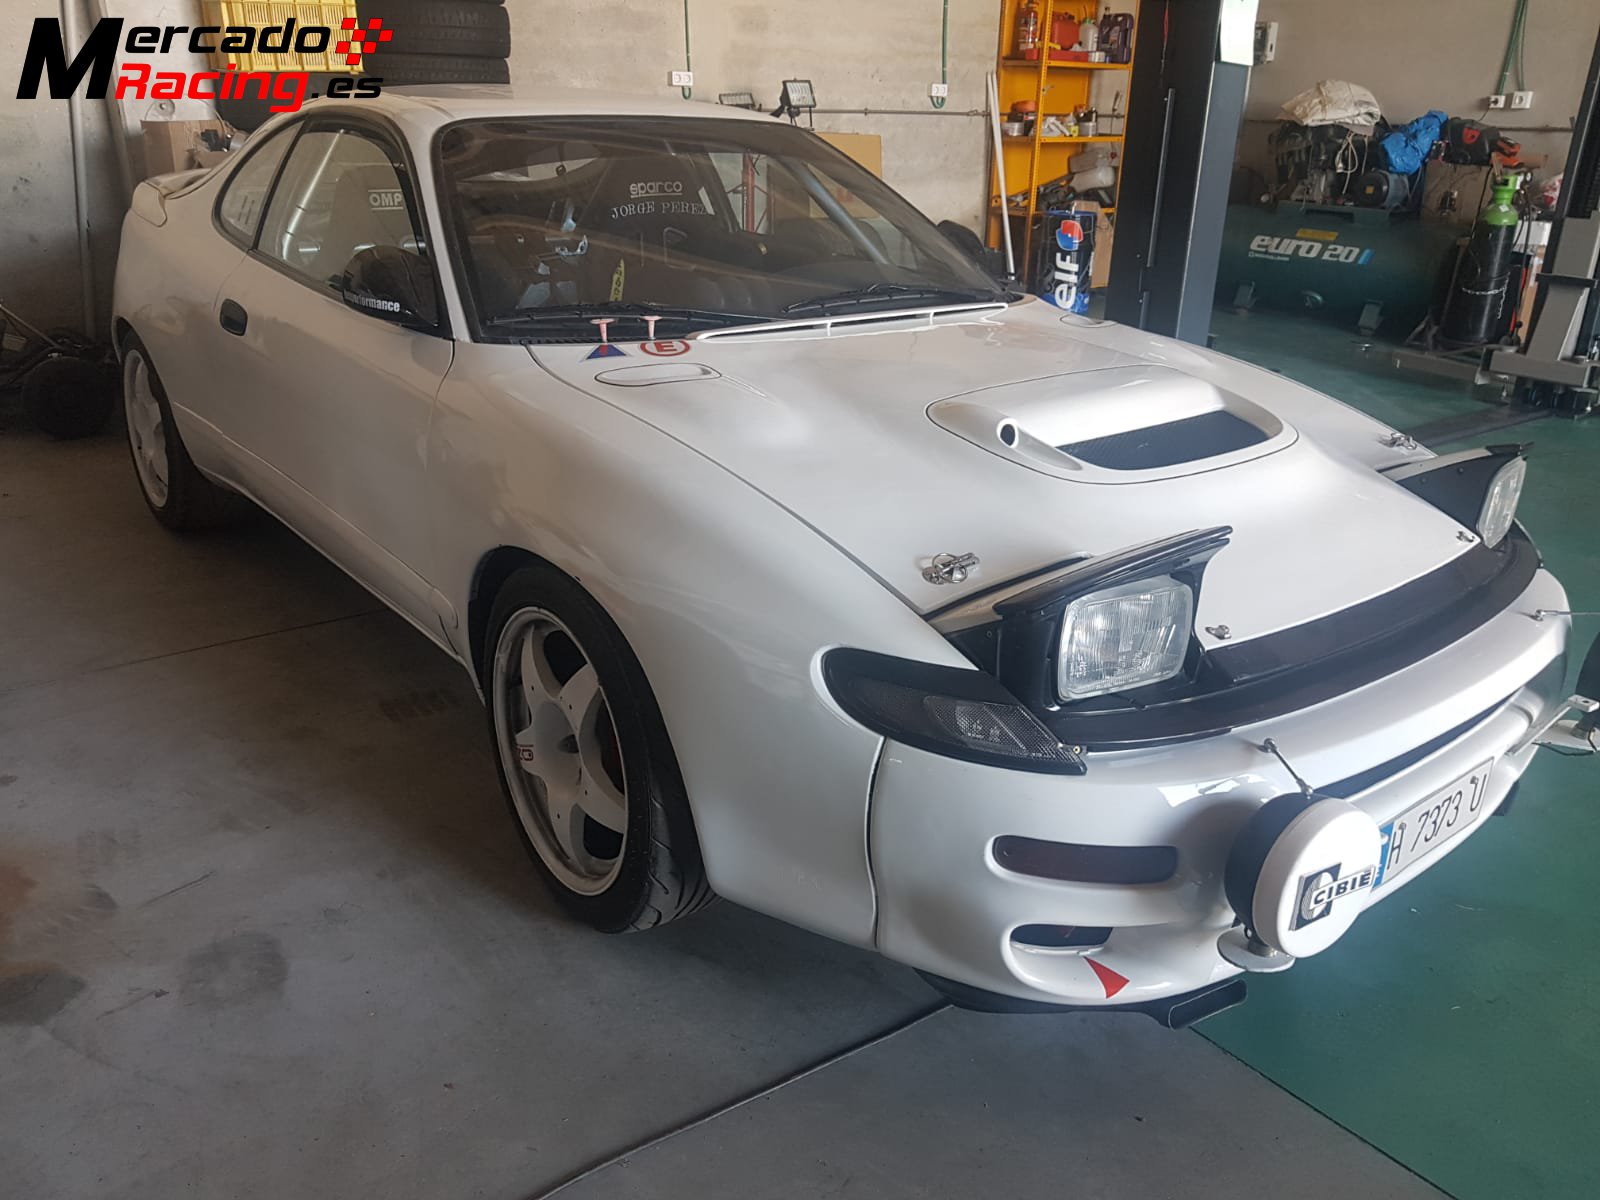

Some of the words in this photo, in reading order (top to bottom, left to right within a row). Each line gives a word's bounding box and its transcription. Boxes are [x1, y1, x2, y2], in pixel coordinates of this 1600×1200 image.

[369, 192, 402, 207] OMP
[629, 181, 682, 195] sparco
[611, 201, 655, 219] JORGE
[1250, 235, 1322, 258] euro
[1322, 244, 1360, 263] 20
[1054, 252, 1079, 309] elf
[1411, 790, 1463, 853] 7373
[1470, 774, 1488, 812] U
[1313, 871, 1372, 905] CIBIE
